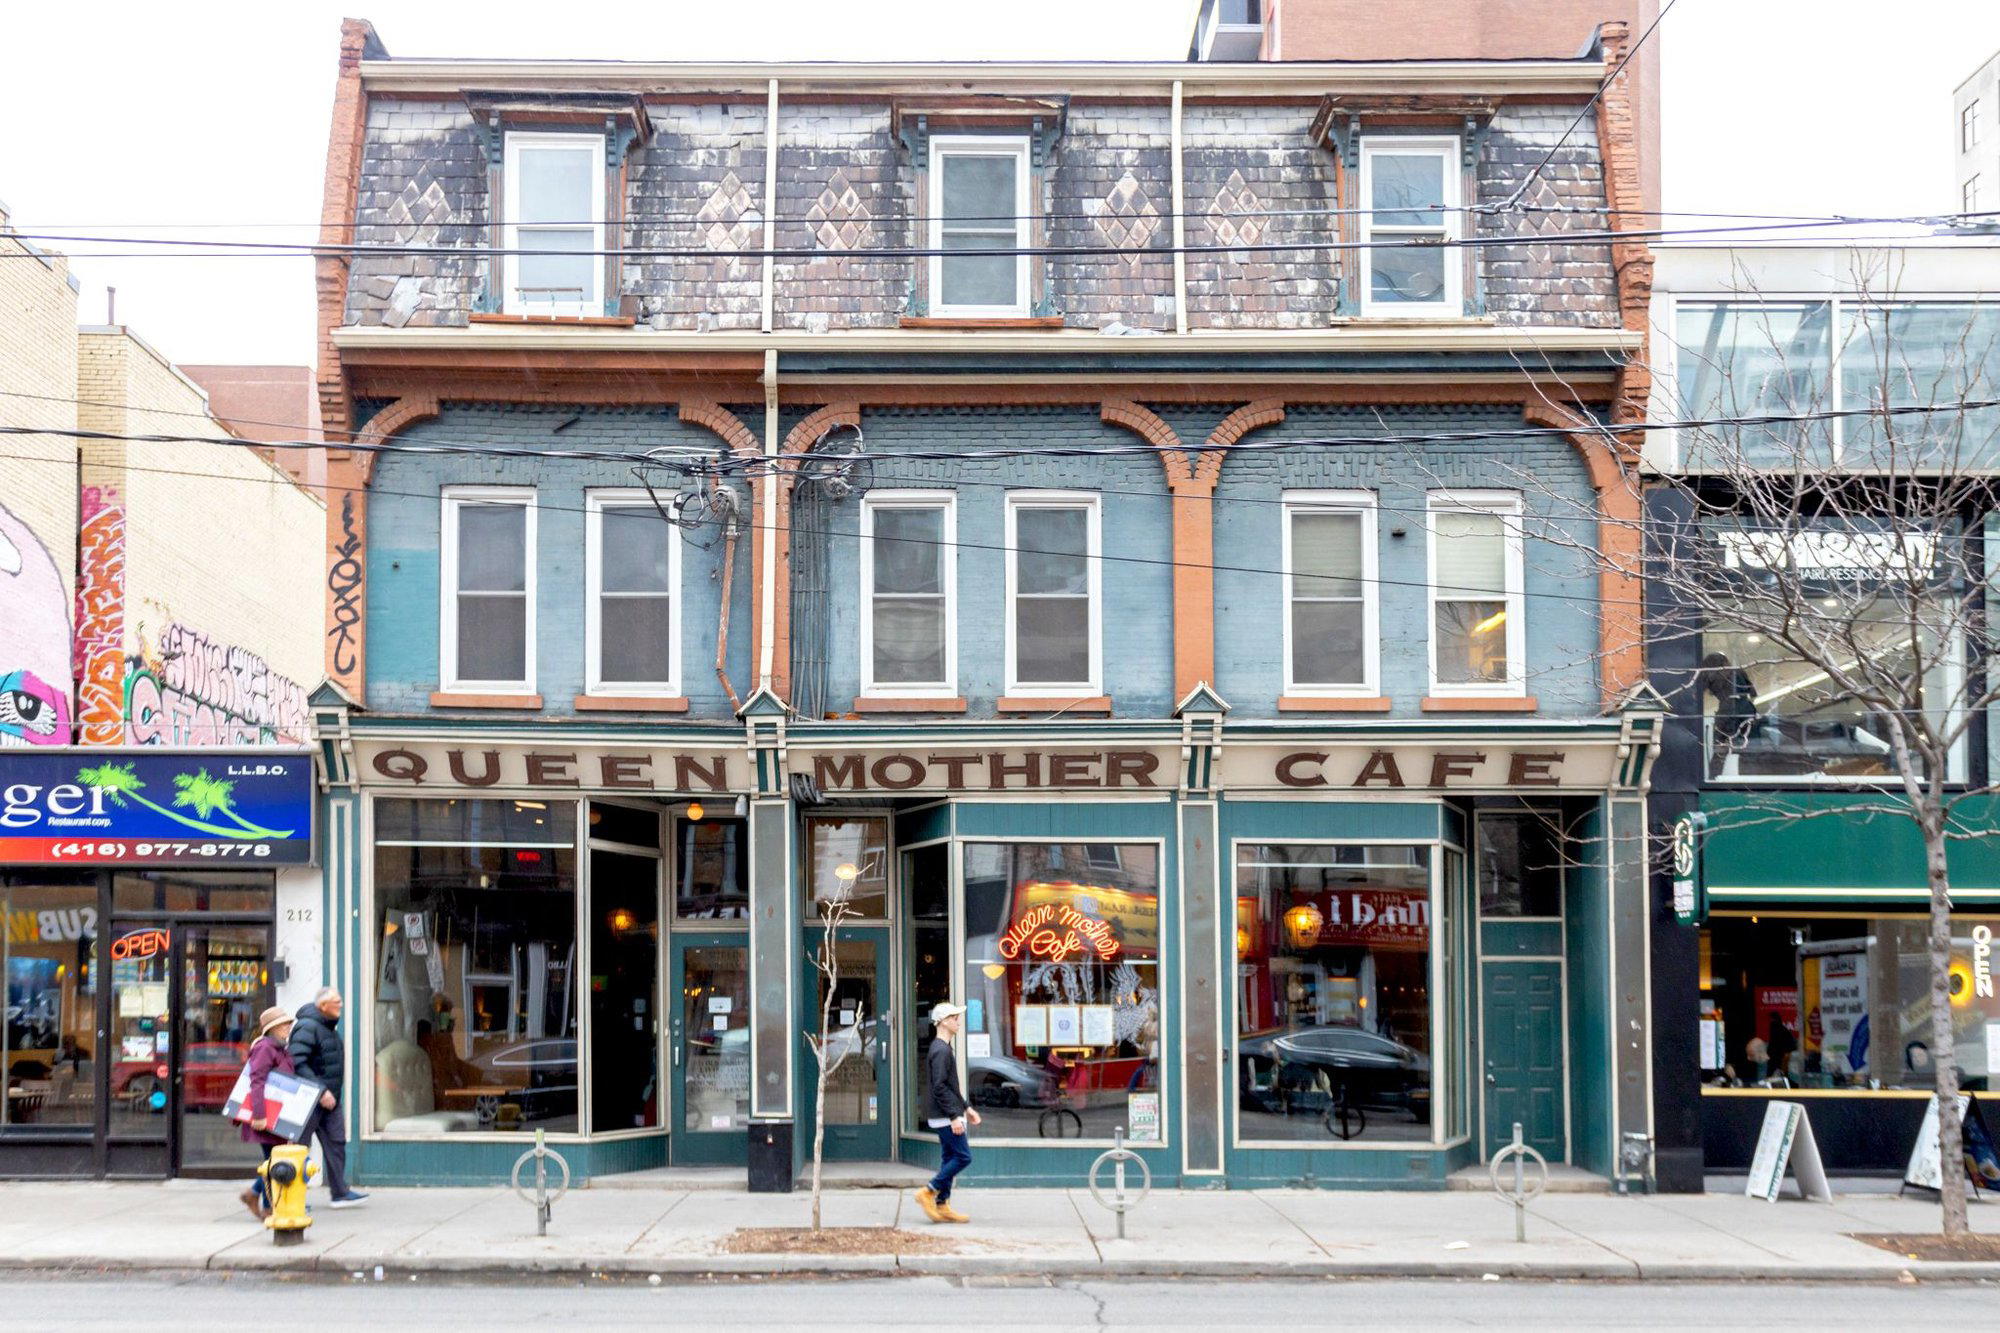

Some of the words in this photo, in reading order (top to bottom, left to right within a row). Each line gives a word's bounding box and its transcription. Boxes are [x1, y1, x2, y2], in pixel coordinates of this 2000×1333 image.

[228, 765, 288, 776] L.L.B.O.
[372, 748, 728, 791] QUEEN
[813, 752, 1160, 790] MOTHER
[1275, 750, 1566, 788] CAFE
[51, 843, 126, 858] (416)
[135, 843, 271, 857] 977-8778
[287, 909, 313, 922] 212
[111, 929, 171, 960] OPEN
[998, 904, 1055, 959] Queen
[1972, 925, 1994, 998] OPEN
